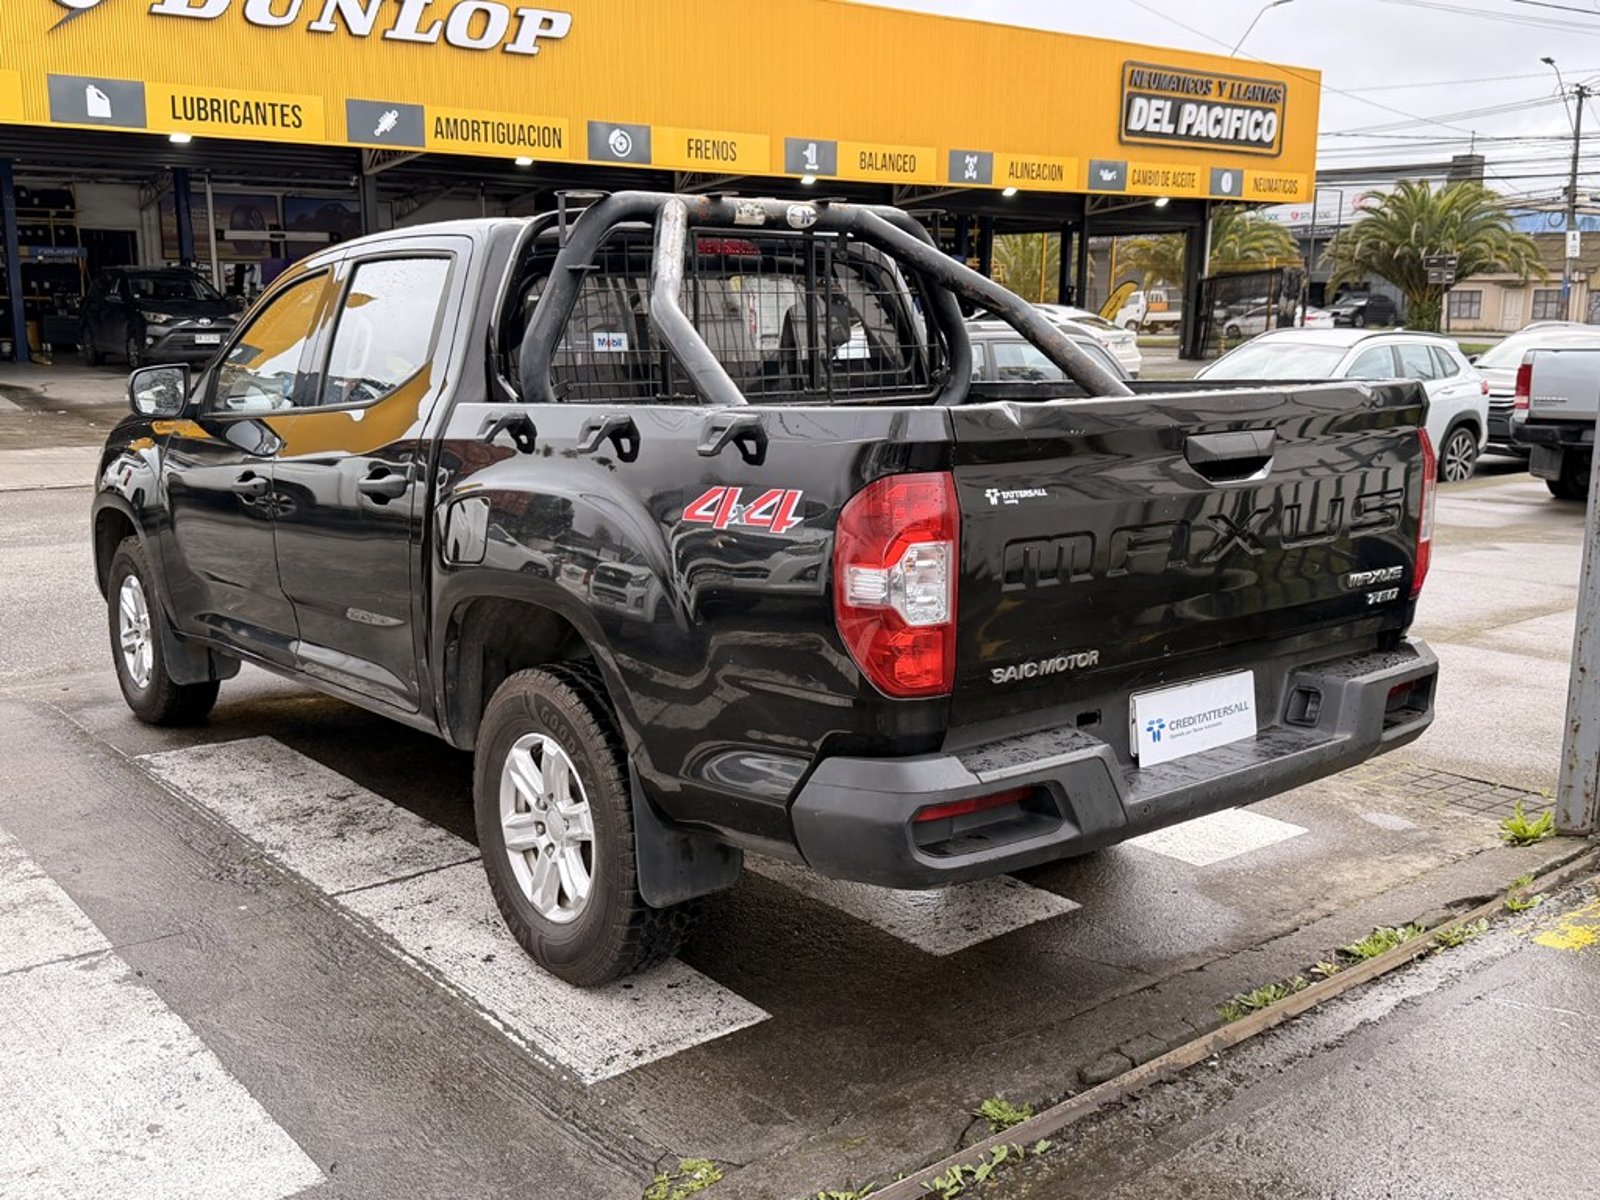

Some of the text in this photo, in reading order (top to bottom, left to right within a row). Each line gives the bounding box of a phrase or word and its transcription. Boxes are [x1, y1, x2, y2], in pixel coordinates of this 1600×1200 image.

[1130, 69, 1283, 103] NEUMATICOS Y LLANTAS
[171, 95, 303, 129] LUBRICANTES
[1127, 97, 1278, 143] DEL PACIFICO
[434, 116, 562, 149] AMORTIGUACION
[687, 138, 738, 162] FRENOS
[859, 151, 917, 173] BALANCEO
[1008, 161, 1064, 181] ALINEACION
[1132, 169, 1196, 189] CAMBIO DE ACEITE
[1252, 177, 1298, 195] NEUMATICOS
[1001, 487, 1048, 499] TATTERSALL
[682, 485, 804, 534] 4x4
[1000, 487, 1404, 592] MAXUS
[990, 649, 1100, 684] SAIC MOTOR
[1168, 700, 1249, 732] CREDITATTERSALL
